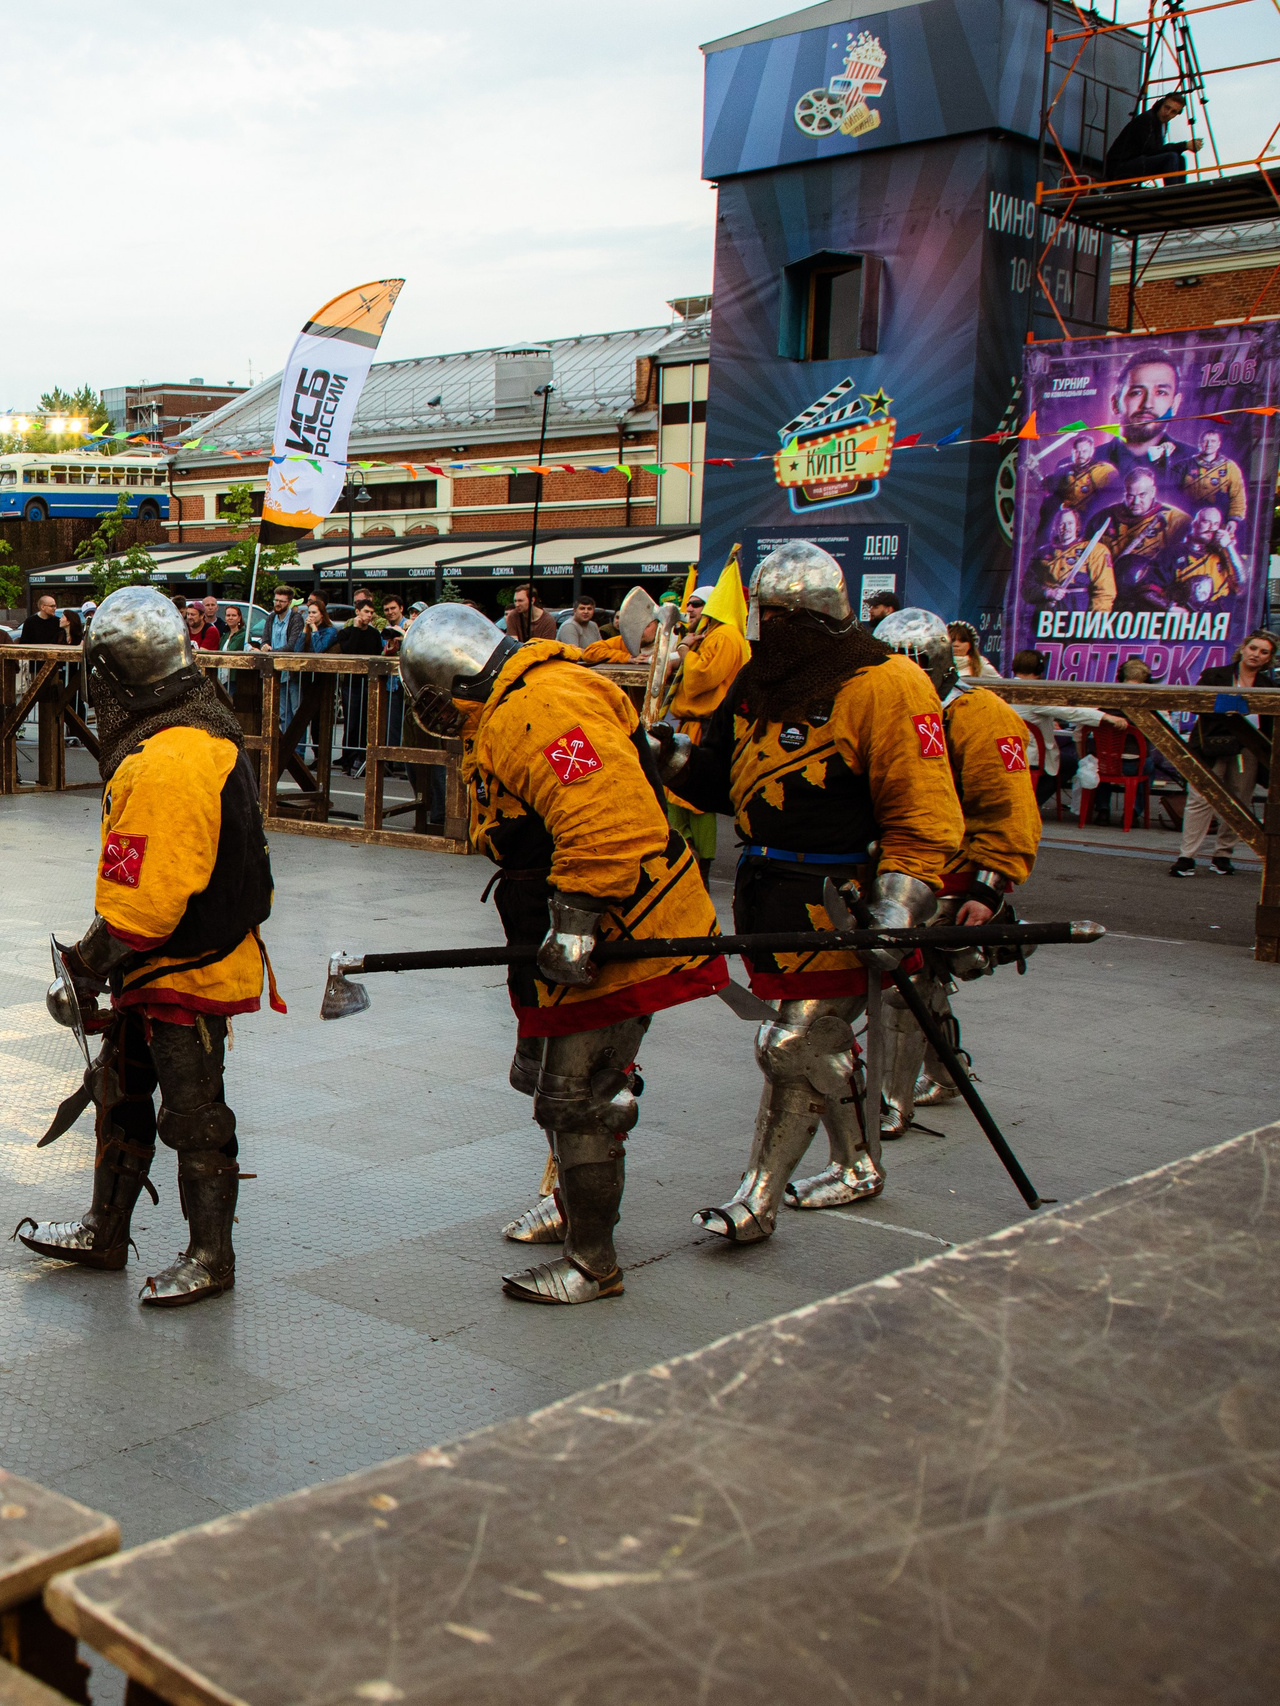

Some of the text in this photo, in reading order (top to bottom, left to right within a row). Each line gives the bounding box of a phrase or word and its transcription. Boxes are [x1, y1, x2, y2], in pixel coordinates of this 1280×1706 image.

[1053, 377, 1090, 391] ТУРНИР
[1200, 360, 1257, 388] 12.06
[285, 367, 330, 454] ИСБ
[314, 373, 348, 458] РОССИИ
[806, 438, 857, 476] КИНО
[863, 535, 898, 555] ДЕПО
[543, 566, 573, 574] ХАЧАПУРИ
[641, 564, 667, 572] ТКЕМАЛИ
[1037, 611, 1231, 640] ВЕЛИКОЛЕПНАЯ
